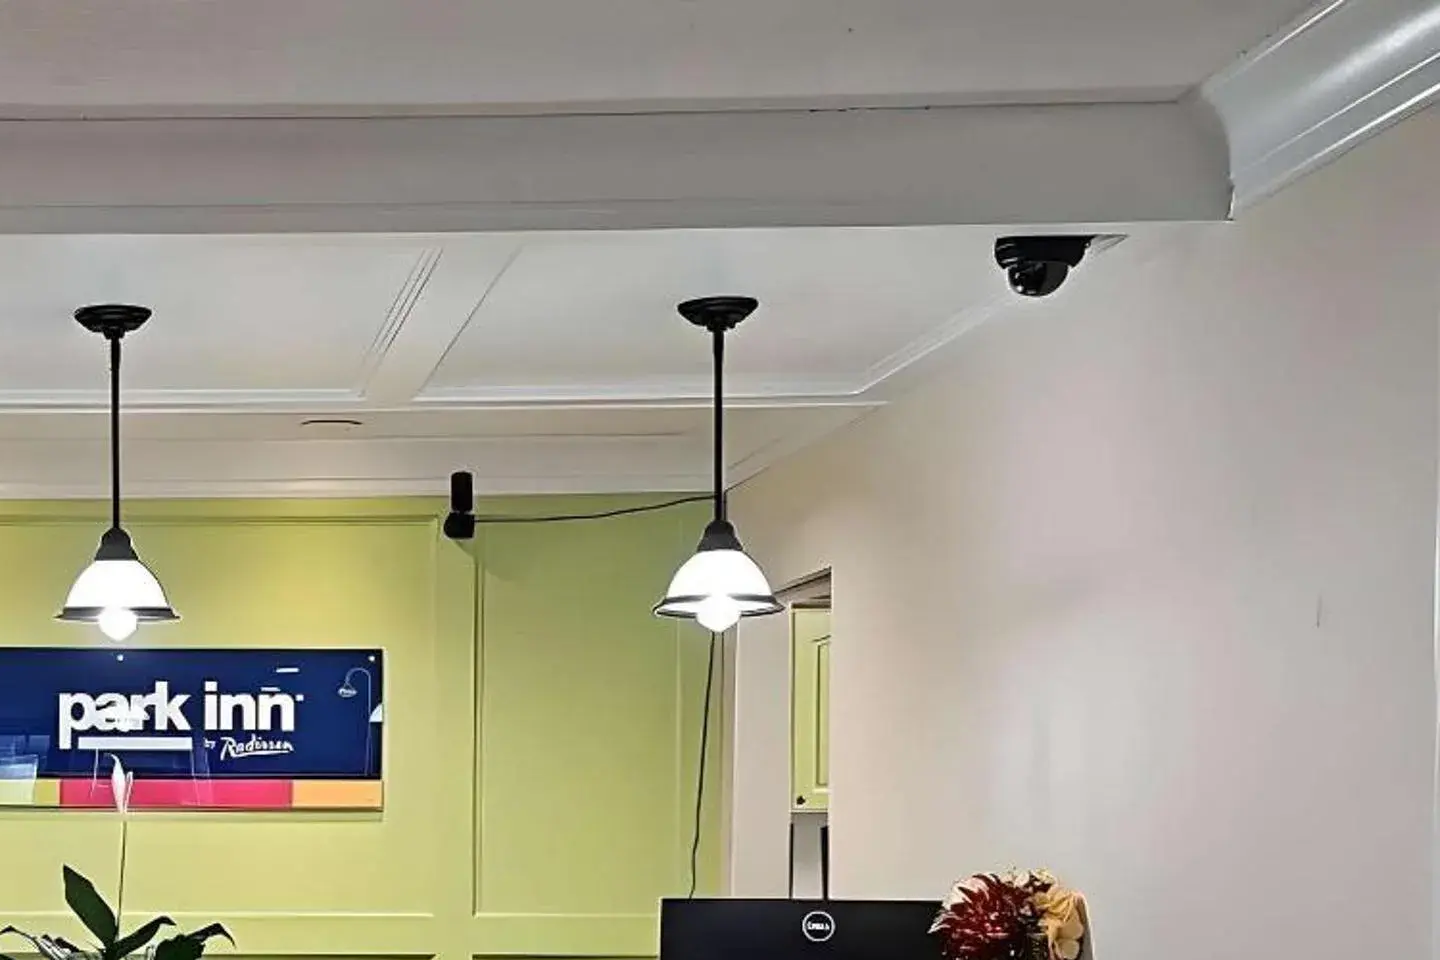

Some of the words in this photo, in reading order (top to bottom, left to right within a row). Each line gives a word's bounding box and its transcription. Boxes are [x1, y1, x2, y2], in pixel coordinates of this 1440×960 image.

[59, 681, 192, 750] park
[204, 681, 296, 731] inn
[220, 733, 294, 761] Radisson
